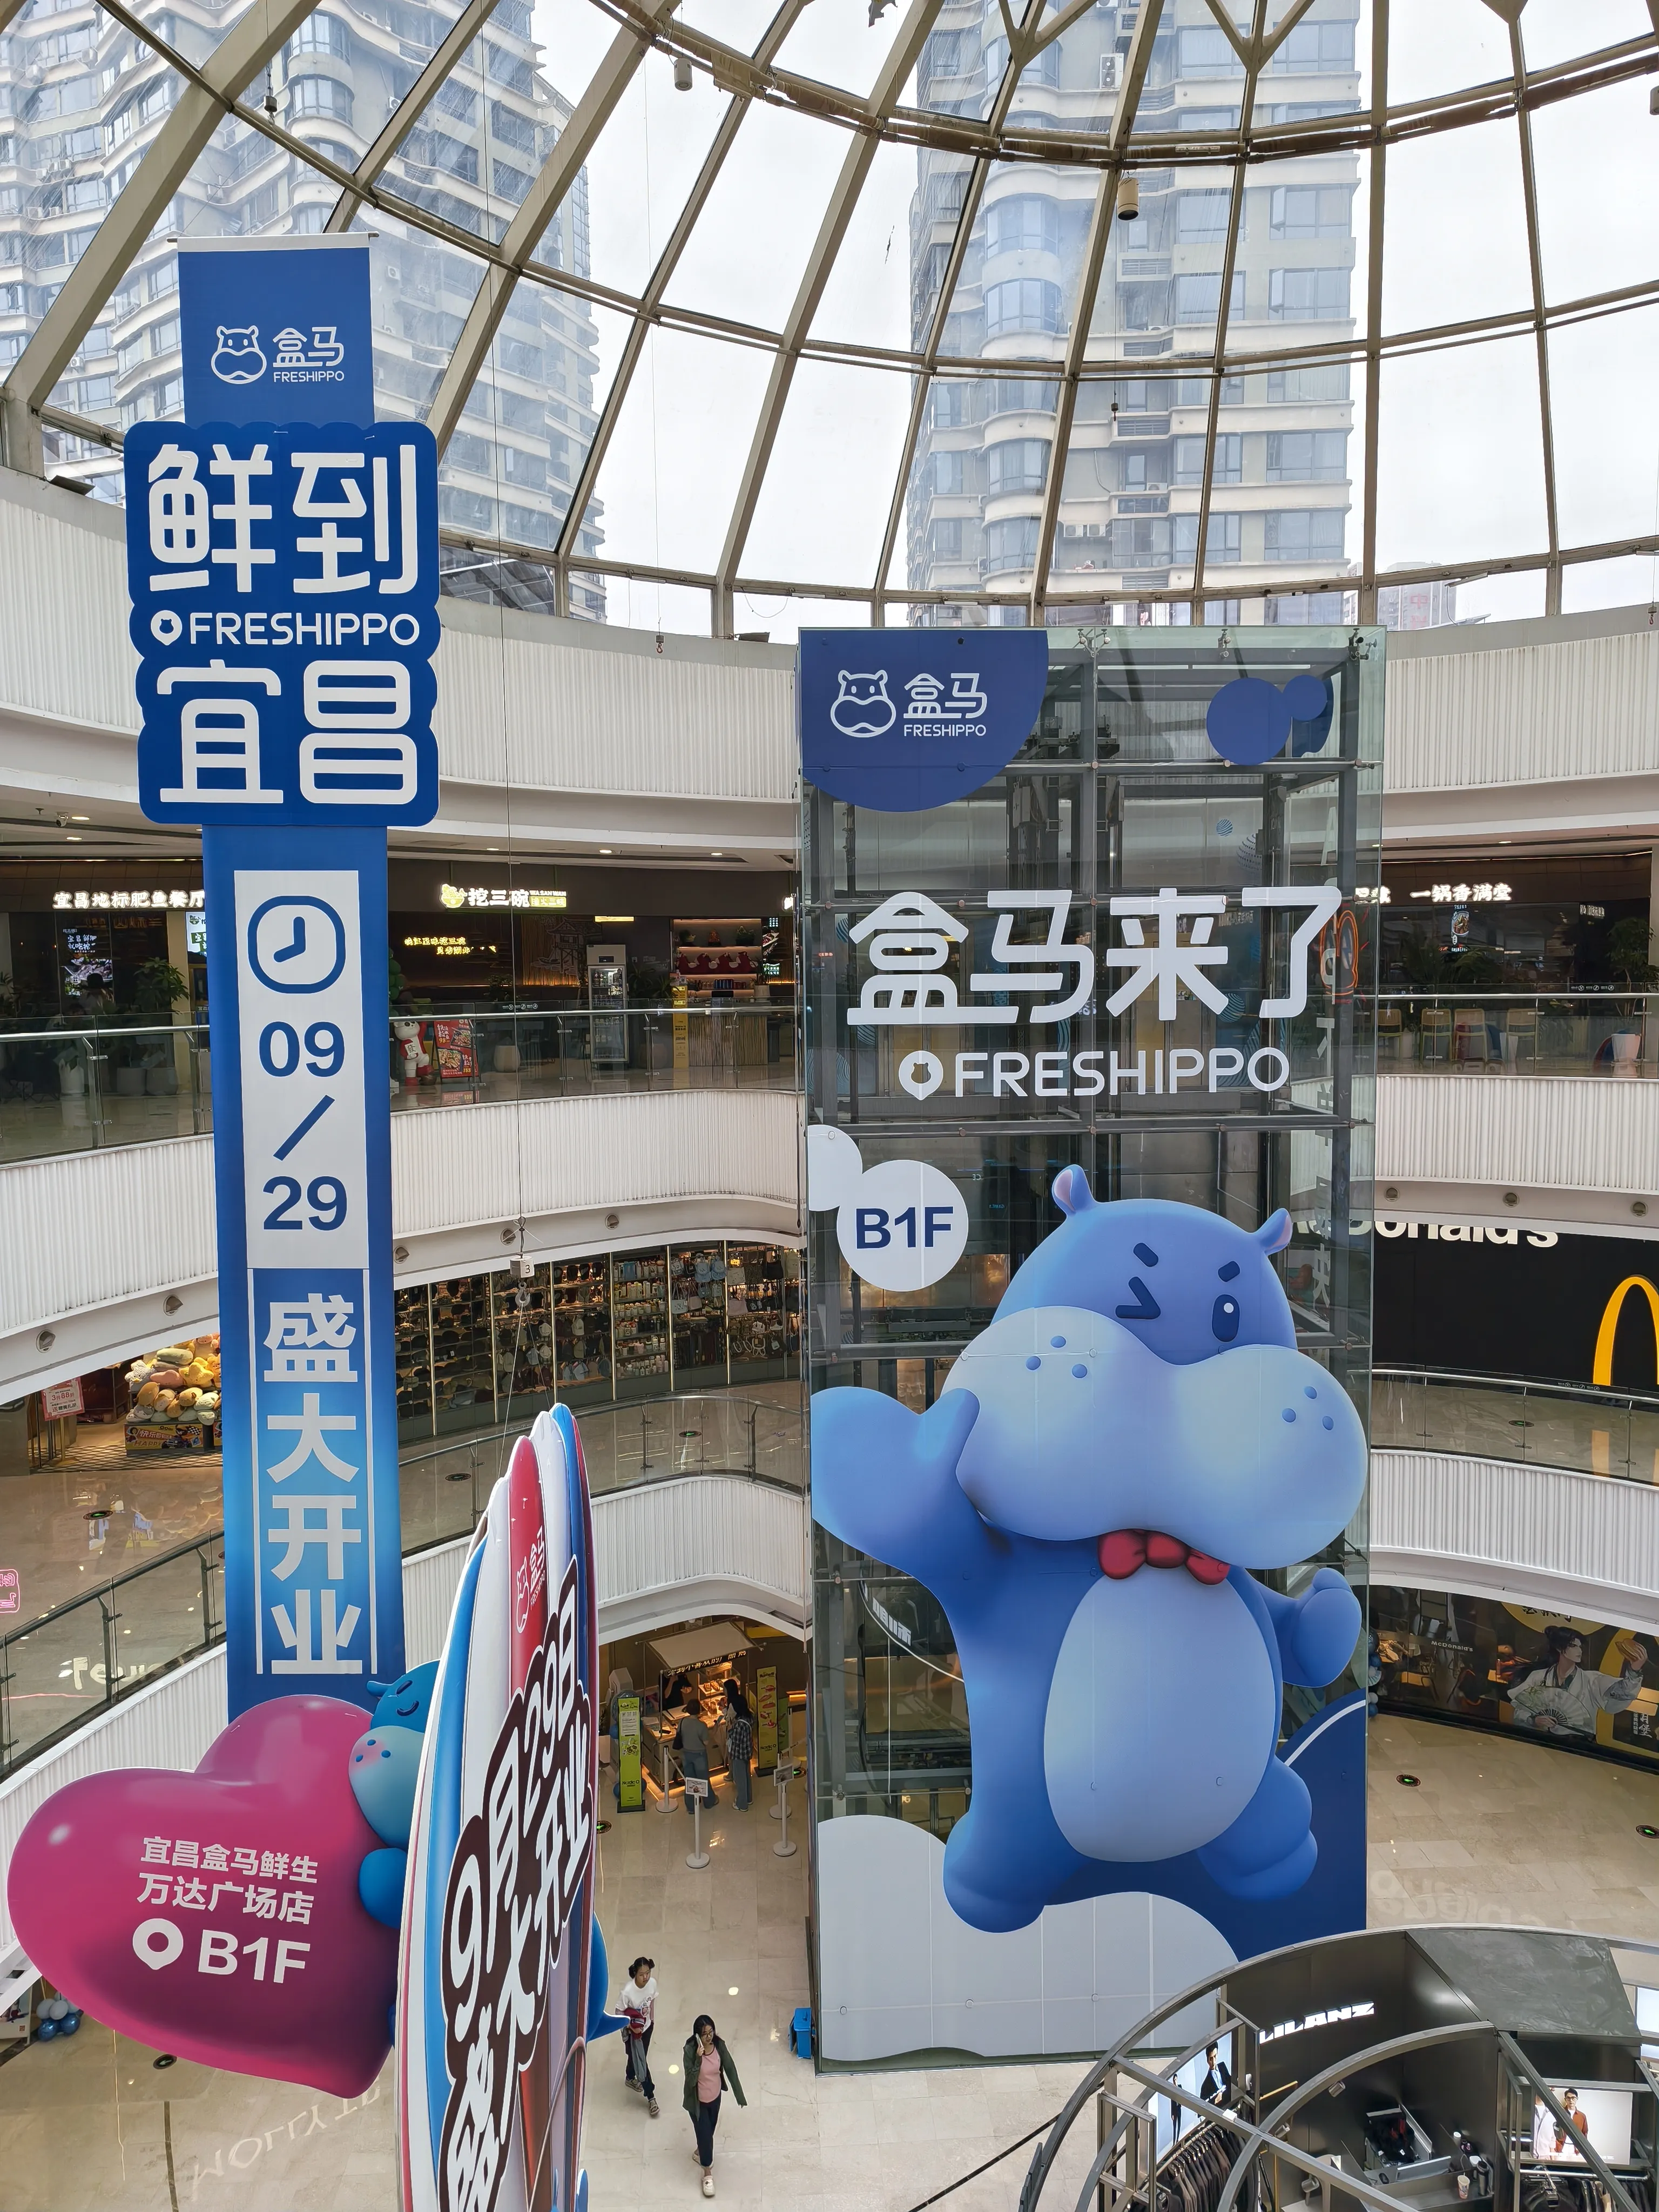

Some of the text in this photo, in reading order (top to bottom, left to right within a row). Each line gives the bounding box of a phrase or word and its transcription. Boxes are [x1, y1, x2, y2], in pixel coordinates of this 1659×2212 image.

[272, 326, 344, 367] 盒马
[273, 370, 345, 382] FRESHIPPO
[149, 444, 418, 594] 鲜到
[190, 612, 420, 645] FRESHIPPO
[903, 672, 987, 718] 盒马
[157, 659, 418, 804] 宜昌
[903, 724, 986, 737] FRESHIPPO
[53, 889, 205, 909] 宜昌地标肥鱼餐厅
[468, 888, 529, 907] 挖三碗
[1410, 882, 1512, 901] 一锅香满堂
[847, 886, 1341, 1026] 盒马来了
[259, 1021, 345, 1077] 09
[955, 1046, 1290, 1098] FRESHIPPO
[262, 1176, 347, 1230] 29
[855, 1205, 954, 1250] B1F
[264, 1293, 362, 1675] 盛大开业
[529, 1525, 544, 1594] 盒马
[1431, 1640, 1473, 1652] McDonald's
[450, 1583, 575, 2042] 9月29日
[140, 1836, 318, 1884] 宜昌盒马鲜生
[137, 1873, 315, 1924] 万达广场店
[198, 1928, 311, 1984] B1F
[1259, 2002, 1374, 2045] LILANZ
